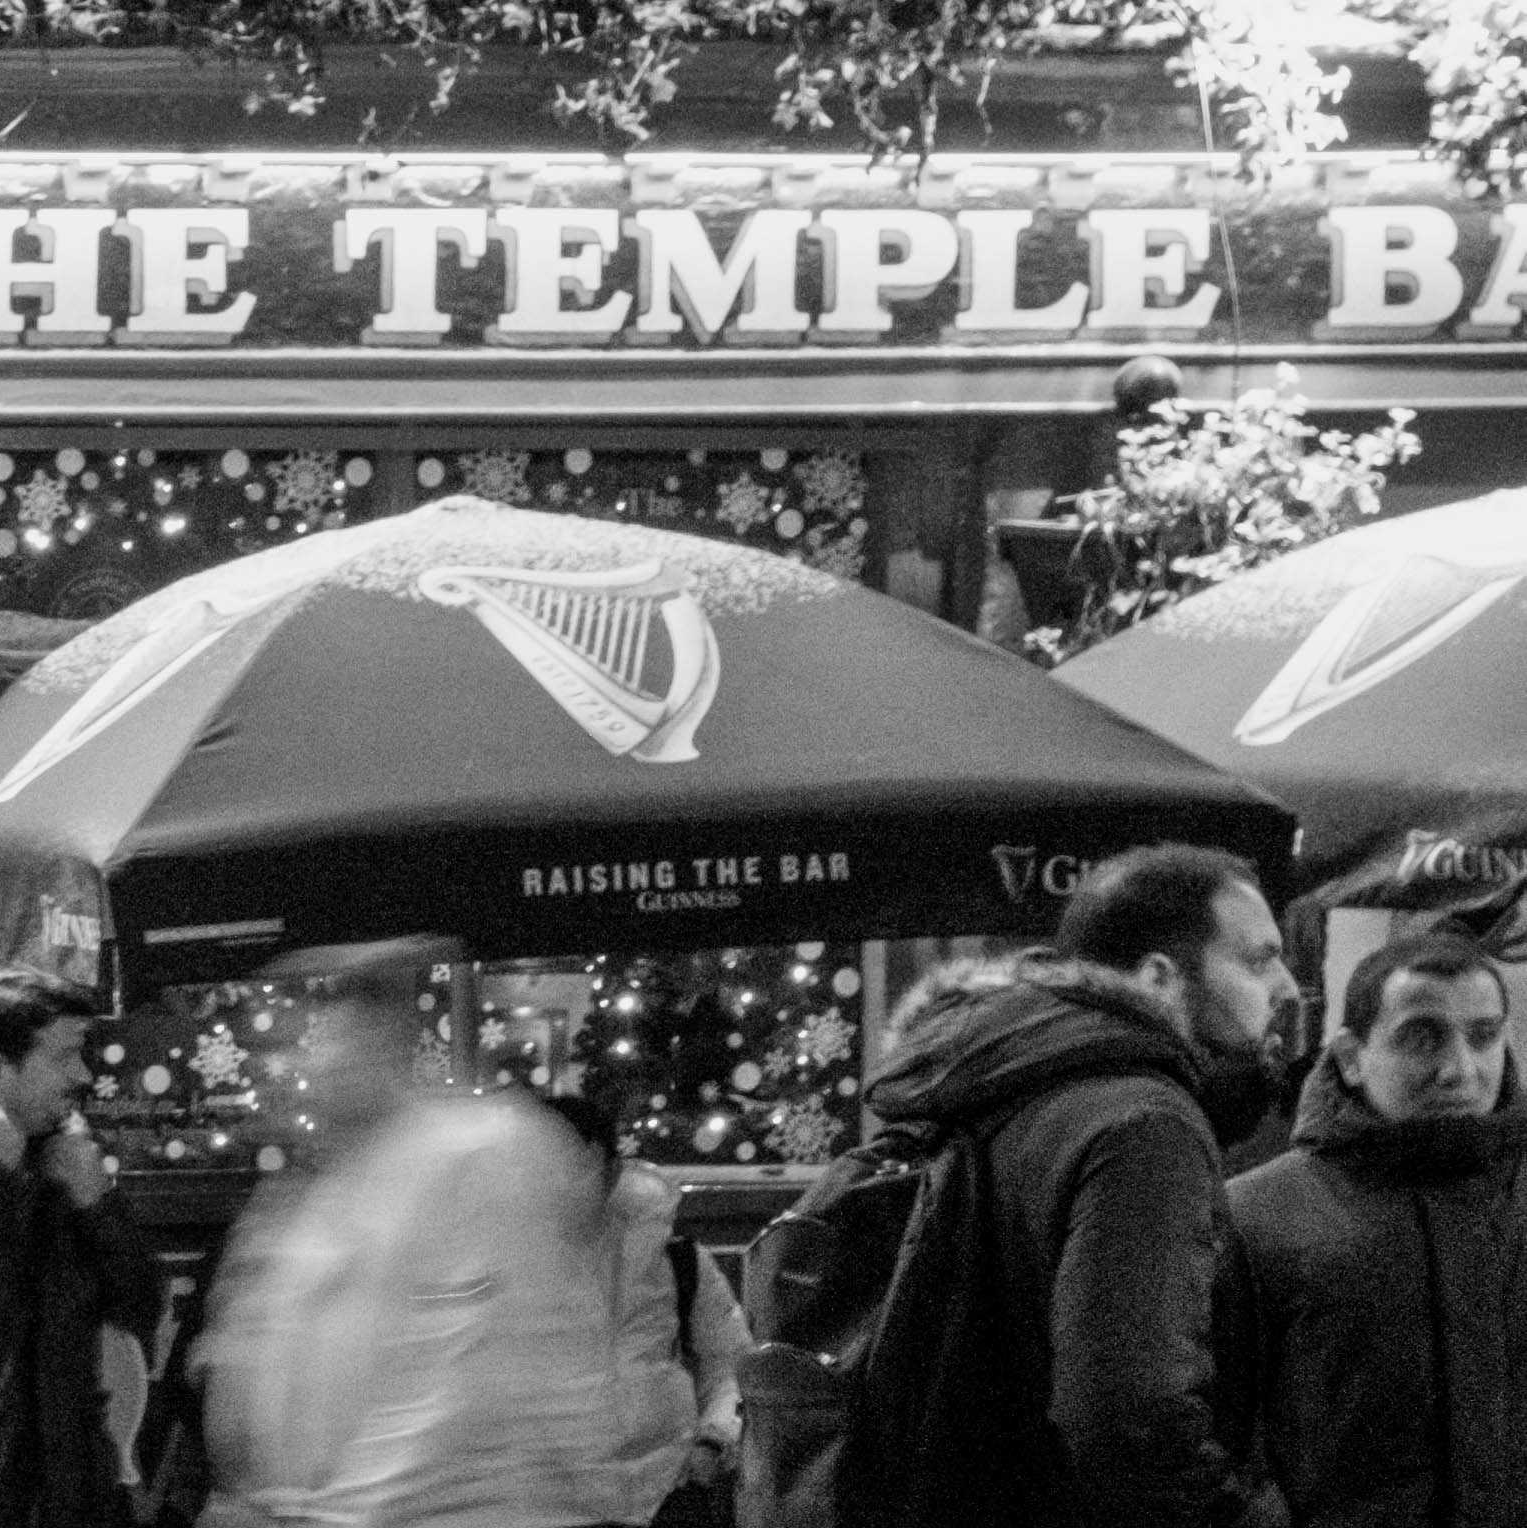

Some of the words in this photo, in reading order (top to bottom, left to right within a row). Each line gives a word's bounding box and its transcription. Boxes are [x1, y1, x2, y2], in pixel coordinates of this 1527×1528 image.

[334, 206, 1222, 343] TEMPLE
[522, 861, 676, 897] RAISING
[692, 857, 763, 887] THE
[780, 852, 851, 883] BAR
[636, 890, 743, 913] GUINNESS
